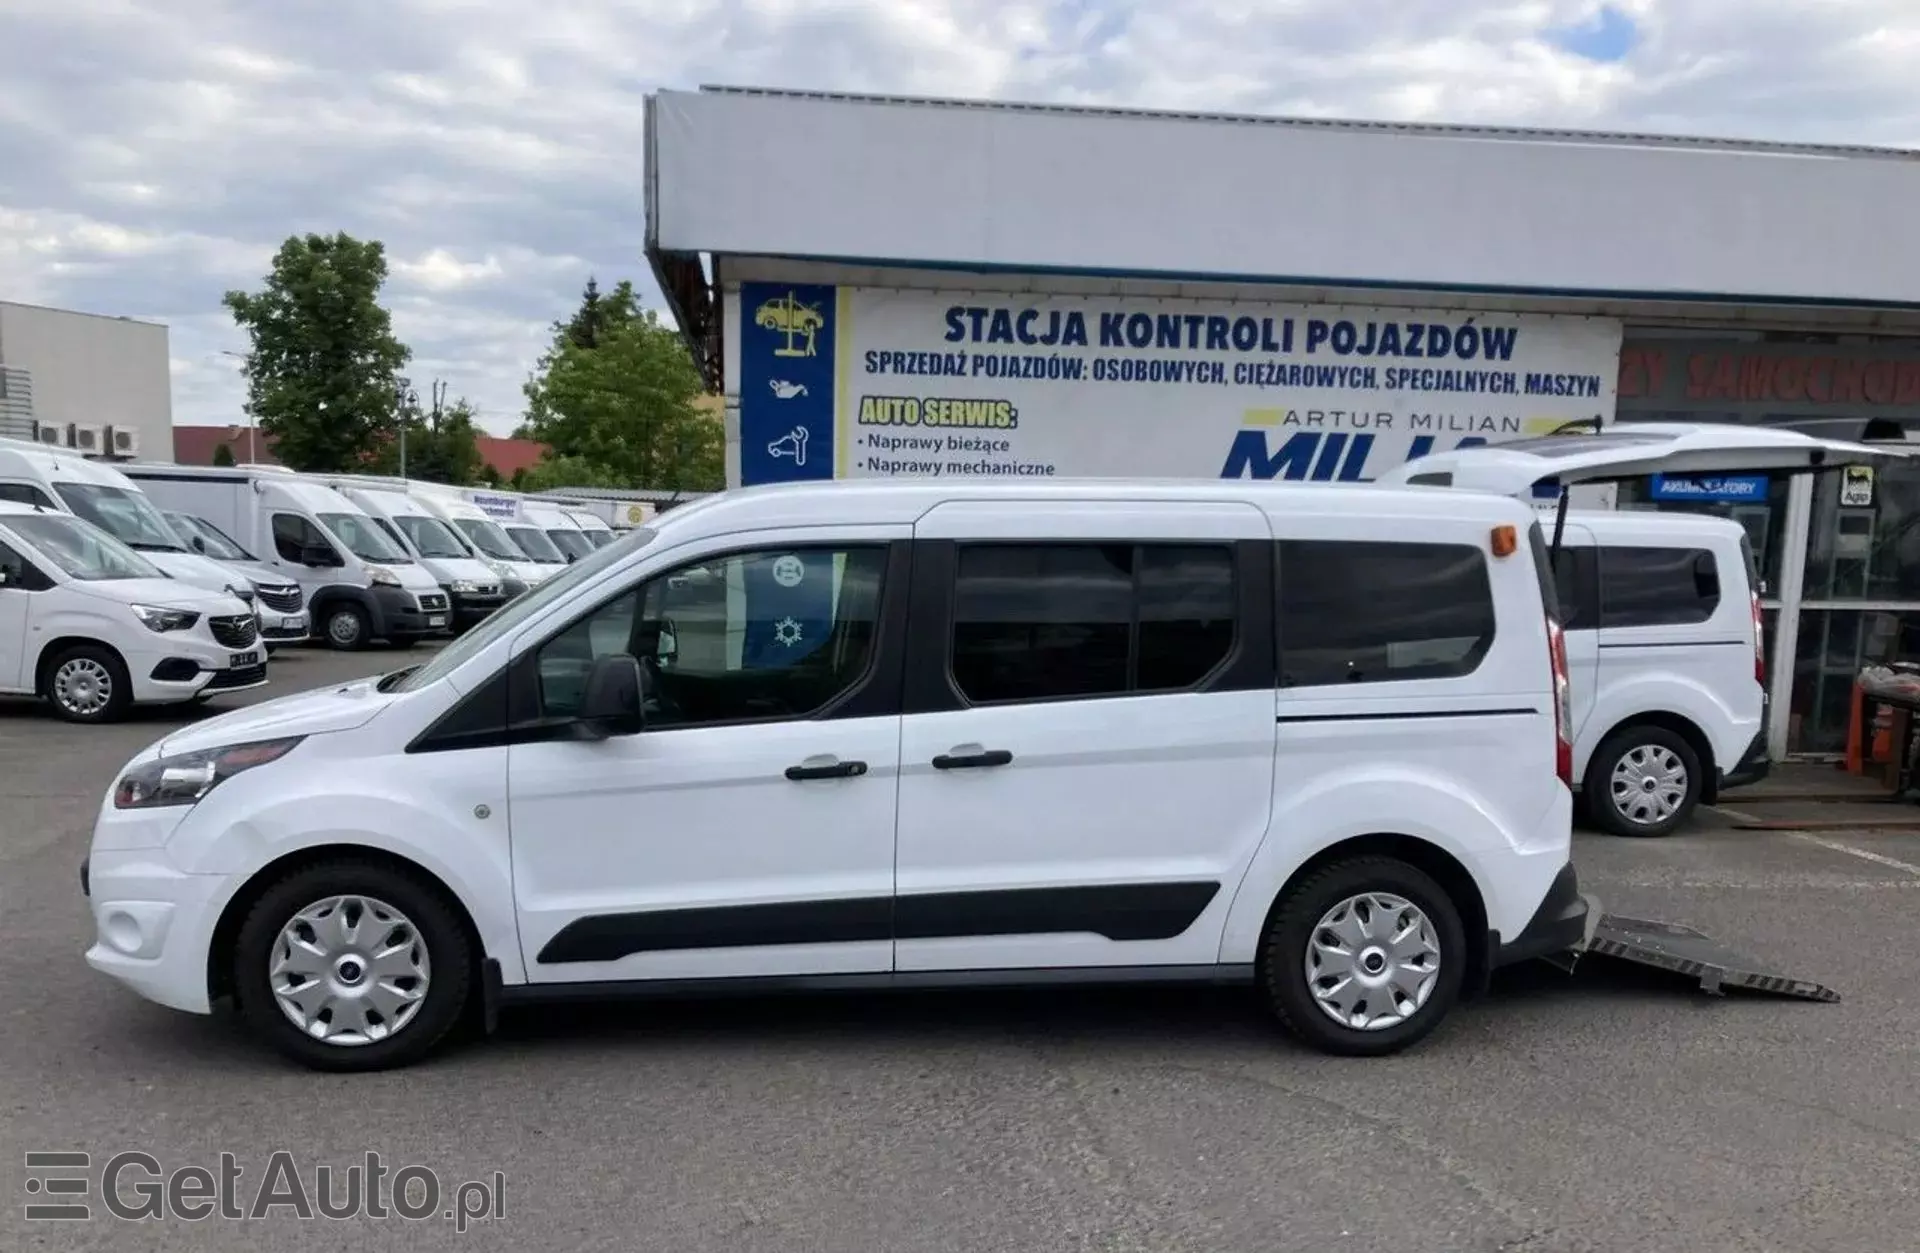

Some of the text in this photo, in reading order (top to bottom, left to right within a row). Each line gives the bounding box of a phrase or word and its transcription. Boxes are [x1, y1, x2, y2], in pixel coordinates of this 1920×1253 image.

[945, 306, 1518, 362] STACJA KONTROLI POJAZDÓW
[865, 350, 1601, 397] SPRZEDAŻ POJAZDÓW: OSOBOWYCH, CIĘŻAROWYCH, SPECJALNYCH, MASZYN
[859, 395, 1018, 429] AUTO SERWIS:
[1282, 409, 1521, 433] ARTUR MILIAN
[868, 434, 1010, 455] Naprawy bieżące
[868, 458, 1055, 476] Naprawy mechaniczne
